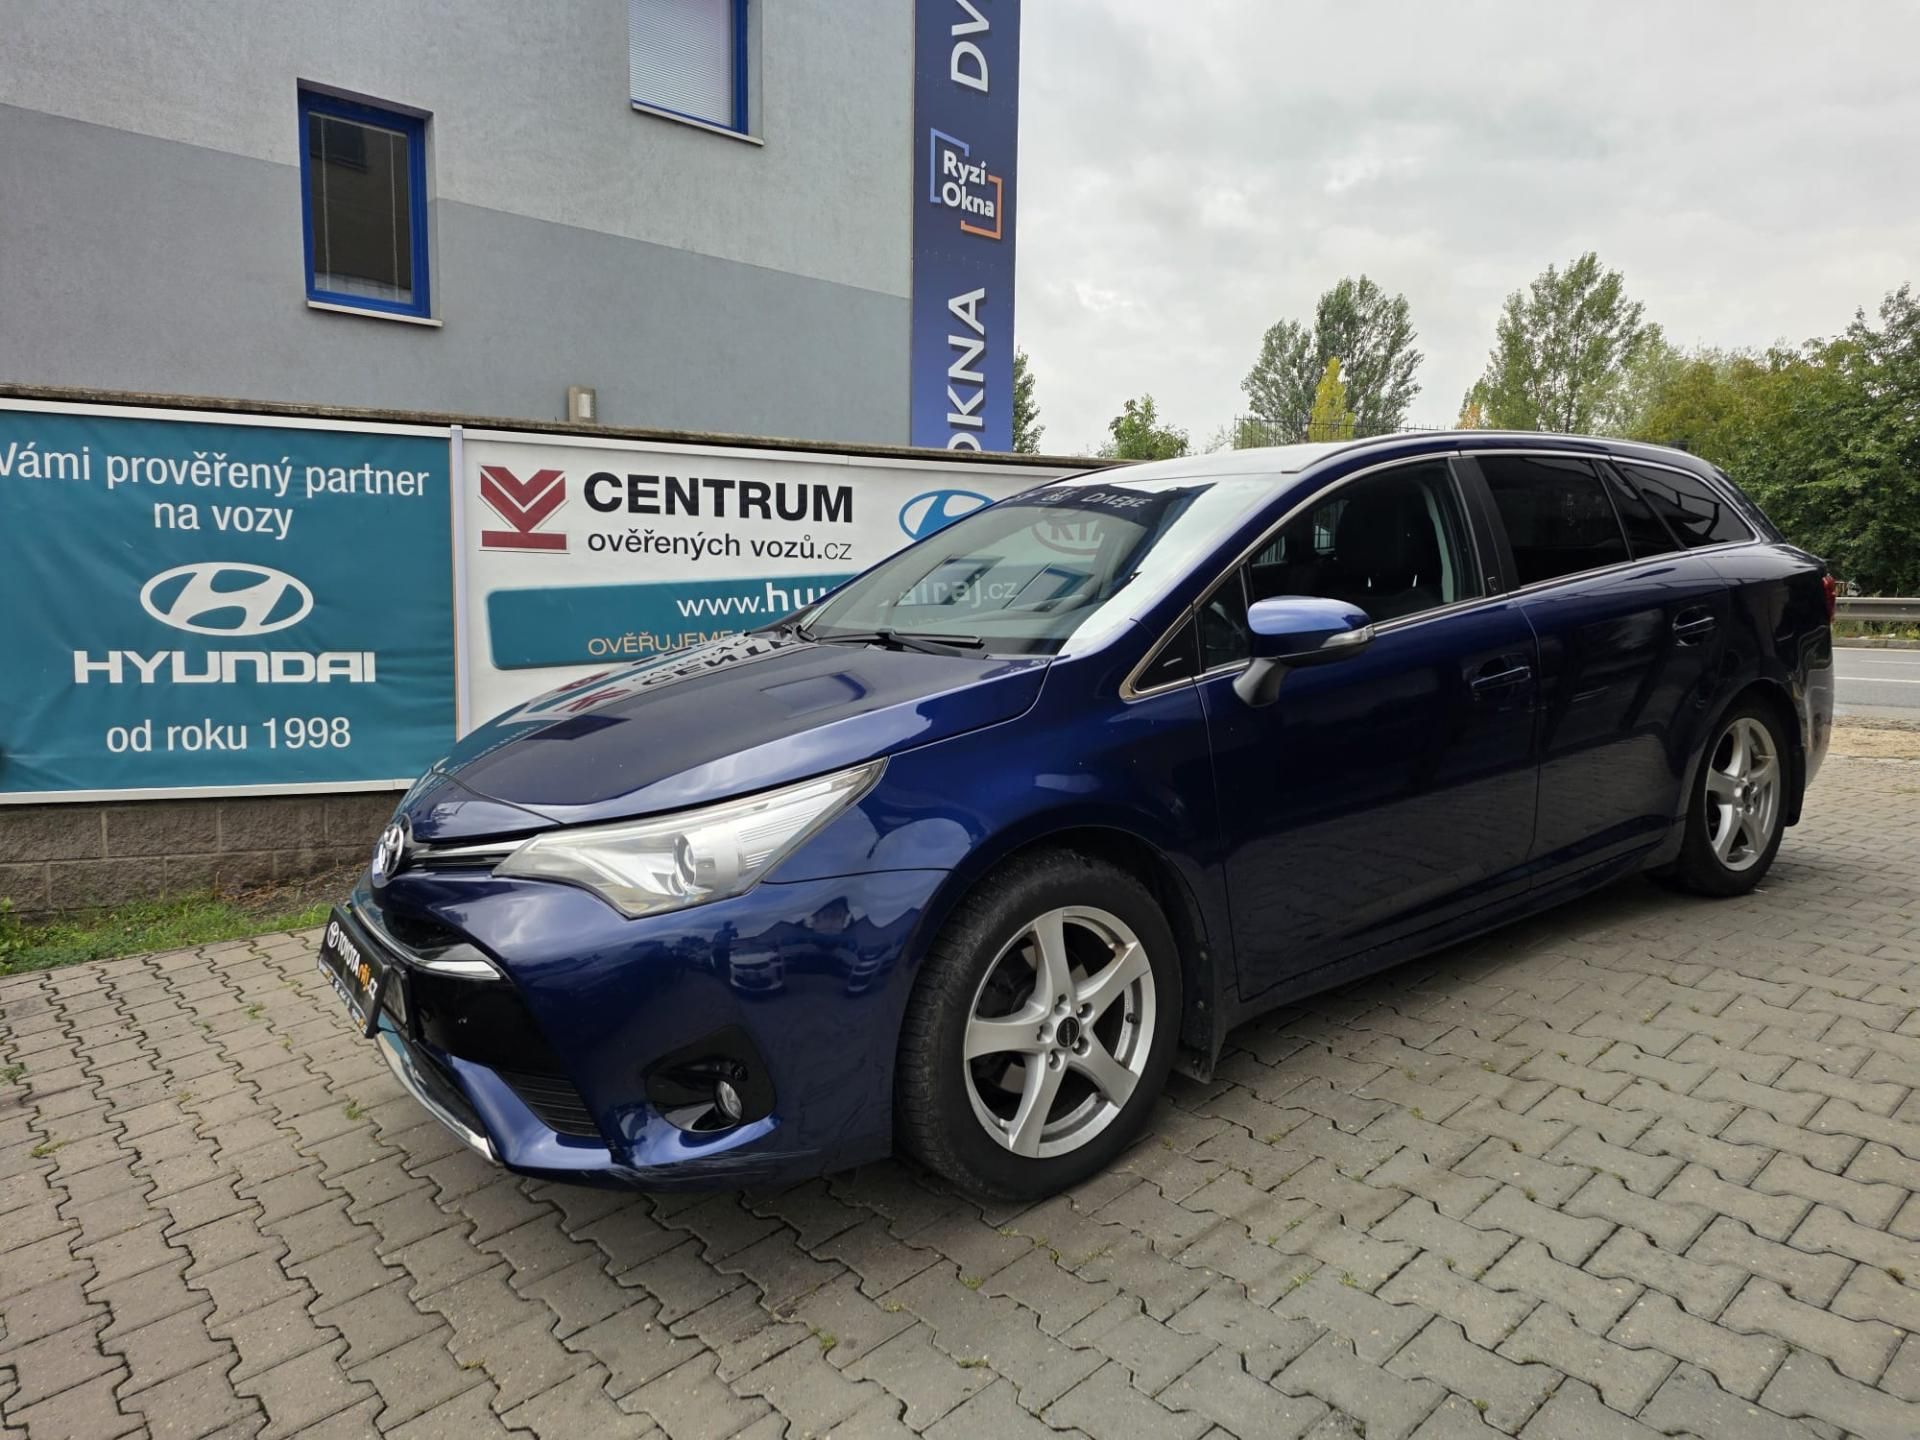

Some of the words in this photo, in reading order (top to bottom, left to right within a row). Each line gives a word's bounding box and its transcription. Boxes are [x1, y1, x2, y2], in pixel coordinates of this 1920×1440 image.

[943, 149, 987, 185] Ryzí
[942, 181, 995, 218] Okna
[106, 451, 292, 497] prověřený
[305, 461, 430, 498] partner
[583, 471, 853, 524] CENTRUM
[154, 502, 200, 530] na
[212, 506, 293, 540] vozy
[587, 528, 741, 561] ověřených
[750, 534, 853, 561] vozů.cz
[74, 650, 376, 684] HYUNDAI
[106, 718, 152, 753] od
[167, 718, 248, 751] roku
[262, 716, 352, 749] 1998
